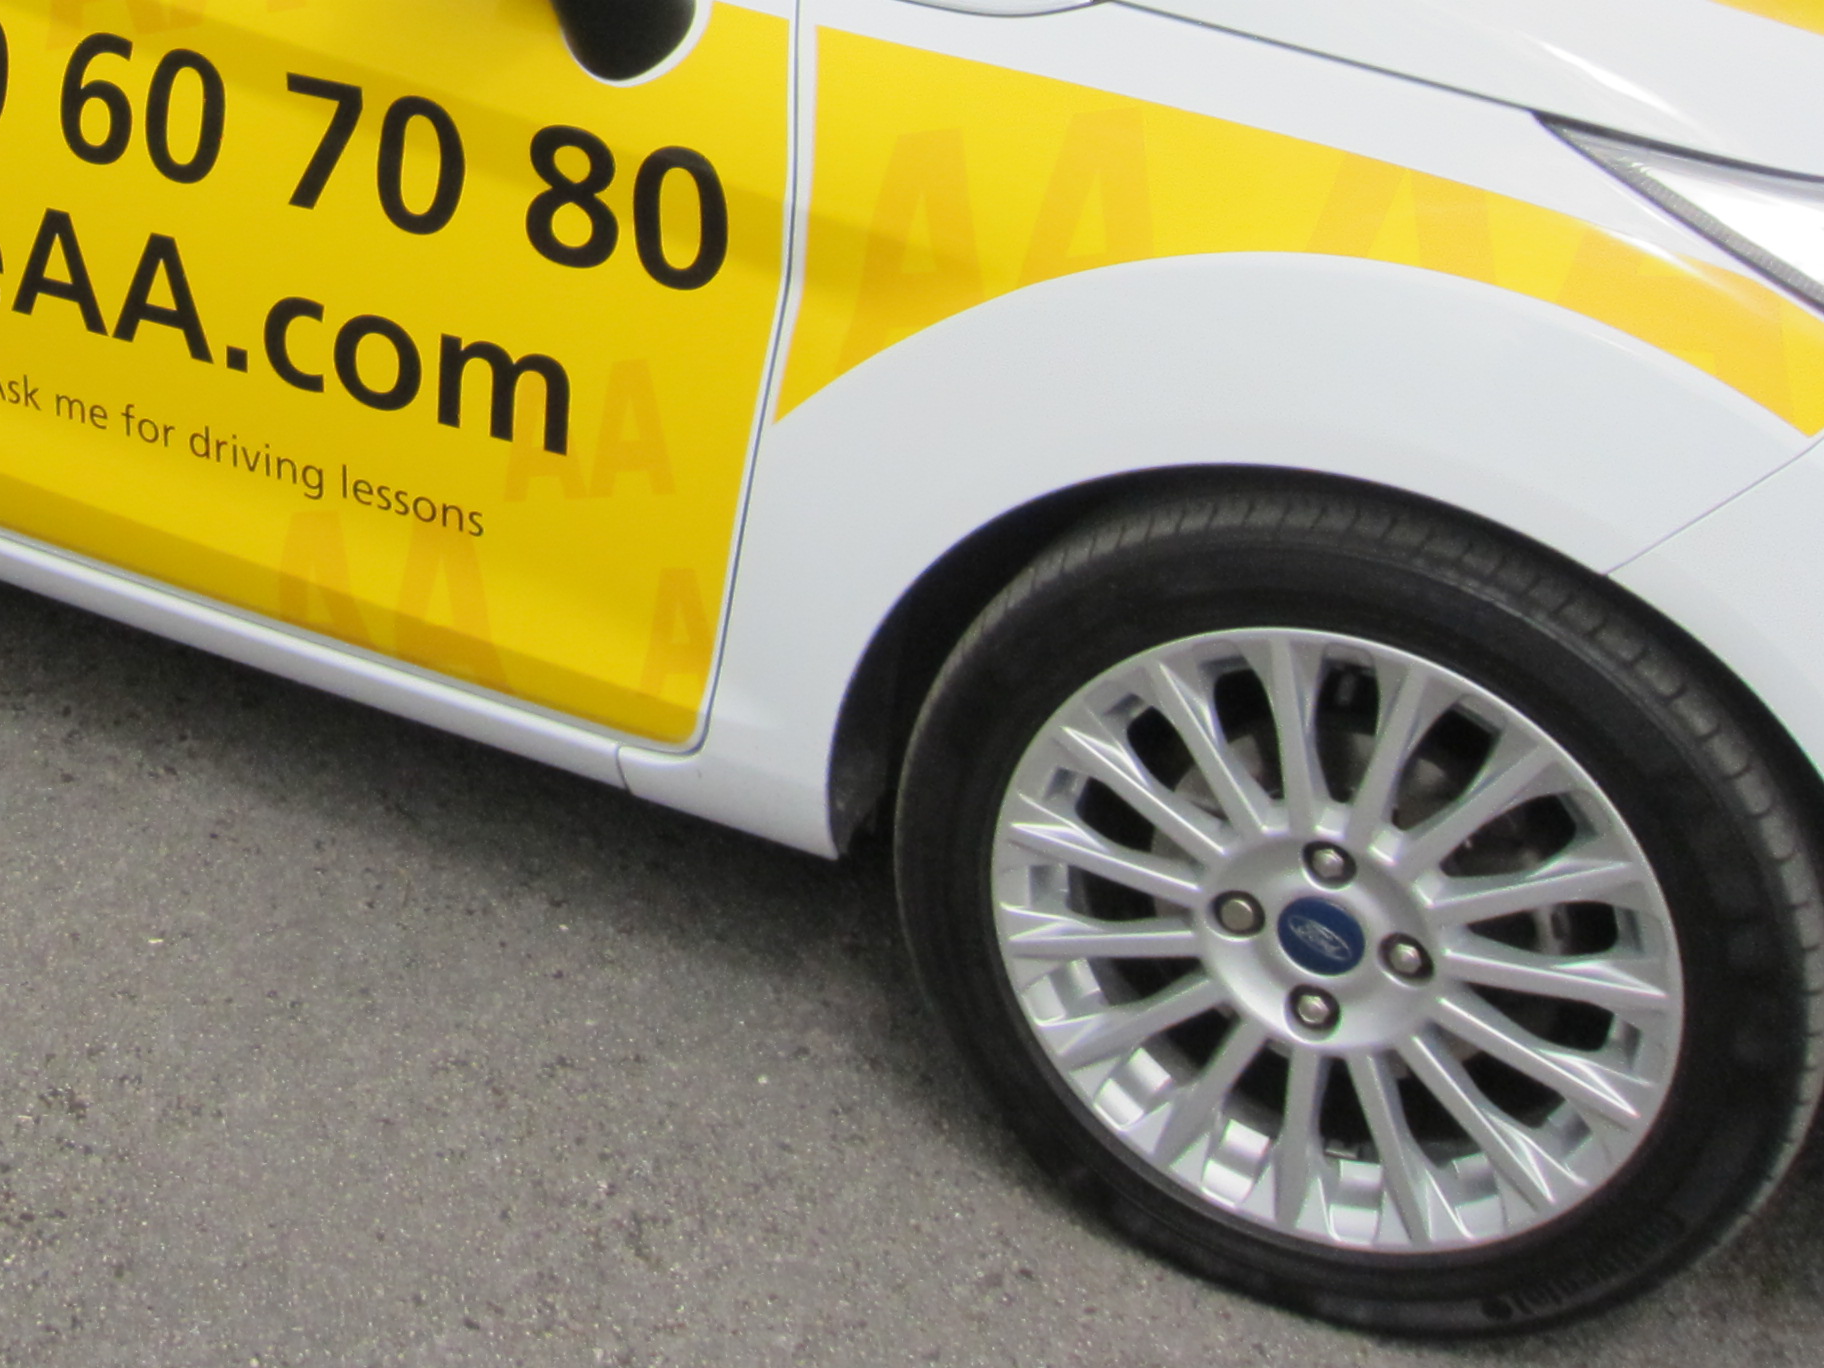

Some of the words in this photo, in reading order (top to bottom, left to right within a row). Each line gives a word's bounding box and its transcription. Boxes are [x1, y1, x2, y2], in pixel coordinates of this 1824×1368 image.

[60, 32, 226, 185] 60
[286, 72, 466, 236] 70
[525, 125, 729, 291] 80
[55, 393, 109, 430] me
[120, 403, 176, 448] for
[188, 426, 324, 500] driving
[341, 464, 485, 537] lessons
